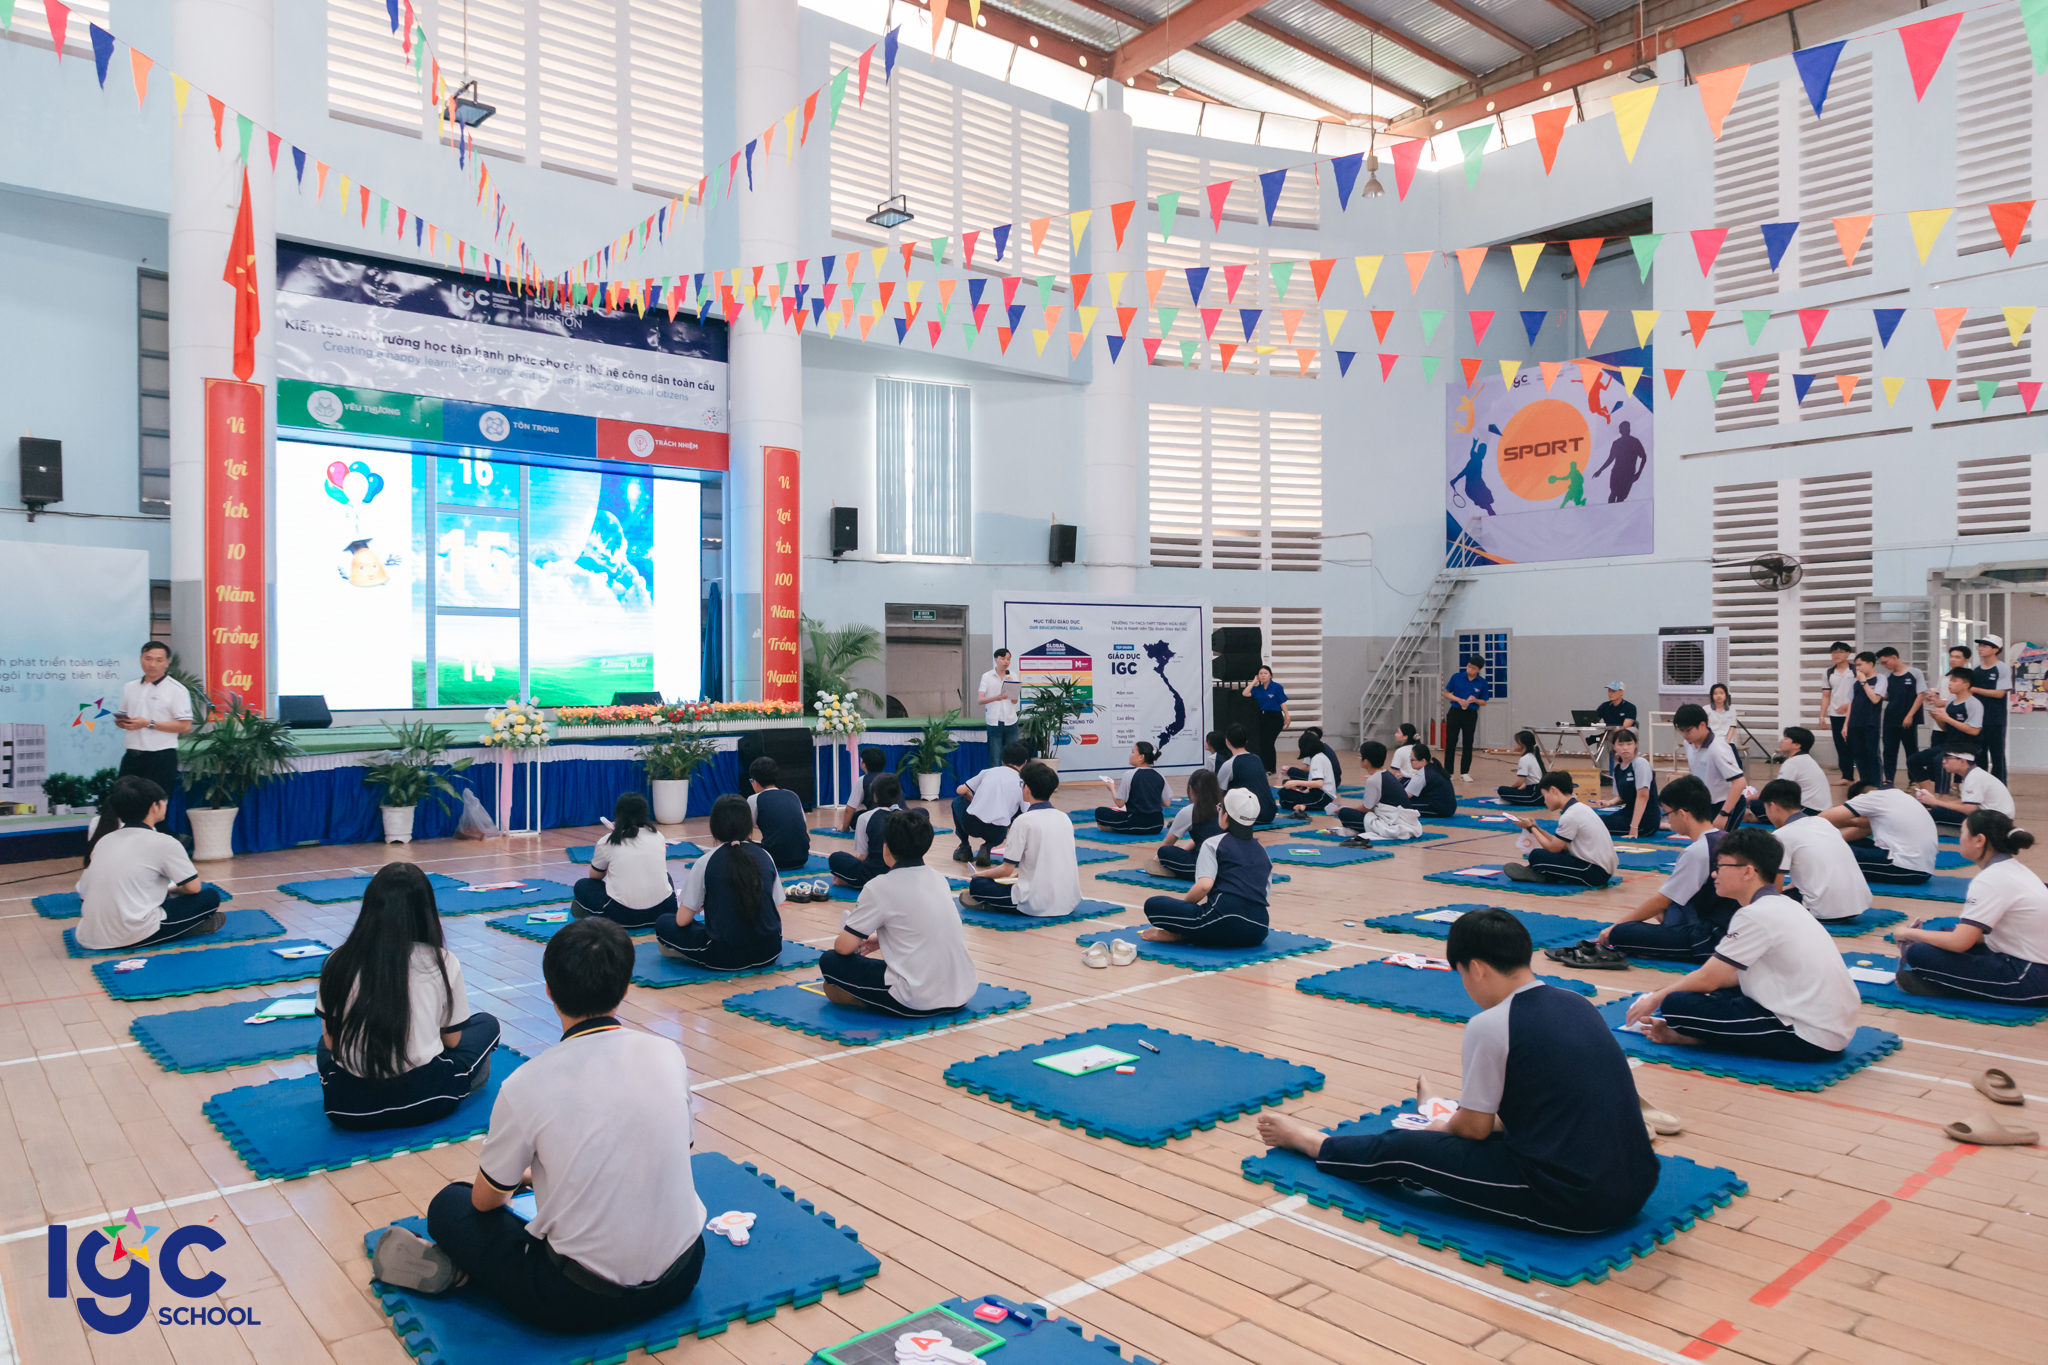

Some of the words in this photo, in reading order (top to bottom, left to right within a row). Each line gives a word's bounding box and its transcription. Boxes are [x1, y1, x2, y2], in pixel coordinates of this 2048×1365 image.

[534, 311, 582, 329] MISSION
[323, 341, 373, 358] Creating
[656, 388, 689, 401] citizens
[424, 339, 447, 354] học
[606, 367, 619, 379] hệ
[622, 370, 648, 383] công
[651, 373, 670, 385] dân
[672, 376, 695, 389] toàn
[697, 378, 715, 391] cầu
[344, 401, 362, 412] YÊU
[513, 420, 531, 430] TÔN
[532, 423, 560, 434] TRỌNG
[655, 438, 677, 448] TRÁCH
[1503, 436, 1584, 462] SPORT
[458, 457, 494, 487] 16
[222, 495, 249, 519] Ích
[227, 543, 246, 560] 10
[775, 536, 792, 554] Ích
[440, 528, 511, 592] 15
[774, 572, 793, 586] 100
[216, 585, 256, 602] Năm
[770, 605, 795, 619] Năm
[212, 625, 259, 649] Trồng
[10, 657, 37, 670] phát
[39, 656, 66, 667] triển
[69, 658, 94, 667] toàn
[96, 657, 120, 668] diện
[1107, 652, 1125, 660] GIÁO
[1126, 653, 1141, 661] DỤC
[460, 652, 495, 682] 14
[1111, 661, 1138, 675] IGC
[26, 671, 66, 681] trường
[72, 671, 92, 680] tiên
[221, 669, 254, 691] Cây
[767, 670, 798, 687] Người
[1432, 1102, 1452, 1117] A
[722, 1214, 748, 1225] C
[910, 1336, 943, 1351] A
